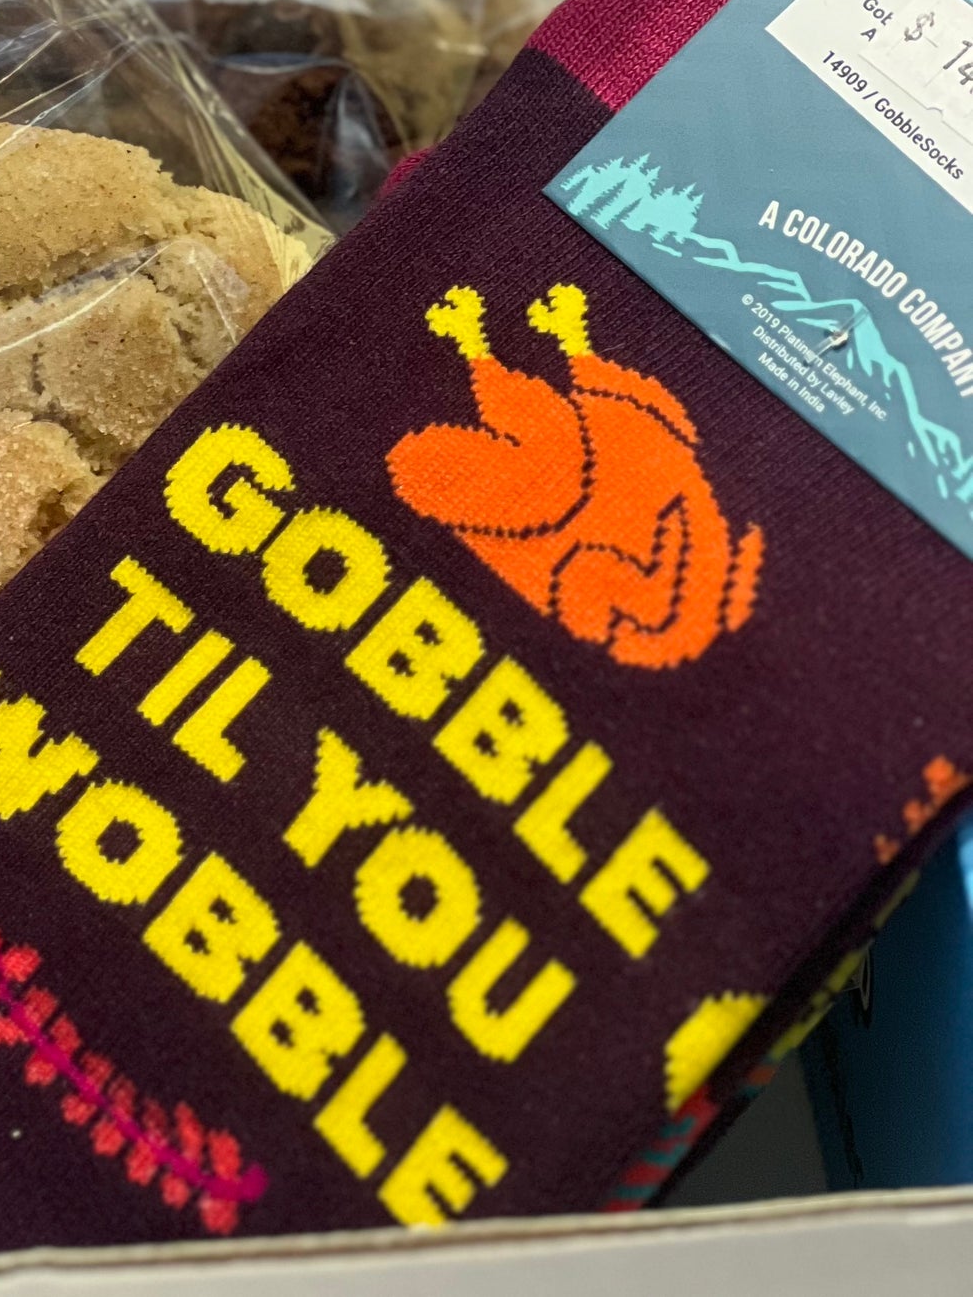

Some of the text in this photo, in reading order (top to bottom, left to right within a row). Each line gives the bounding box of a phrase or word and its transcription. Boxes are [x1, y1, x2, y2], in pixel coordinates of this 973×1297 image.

[860, 28, 877, 42] A
[823, 50, 868, 92] 14909
[874, 97, 964, 180] GobbleSocks
[758, 200, 780, 230] A
[782, 209, 908, 298] COLORADO
[751, 303, 780, 329] 2019
[777, 325, 824, 367] Platinm
[822, 363, 869, 407] Elephant,
[752, 325, 855, 415] Distributed by Lavley
[758, 351, 825, 413] Made in India
[163, 424, 711, 960] GOBBLE
[74, 555, 577, 1064] TIL YOU
